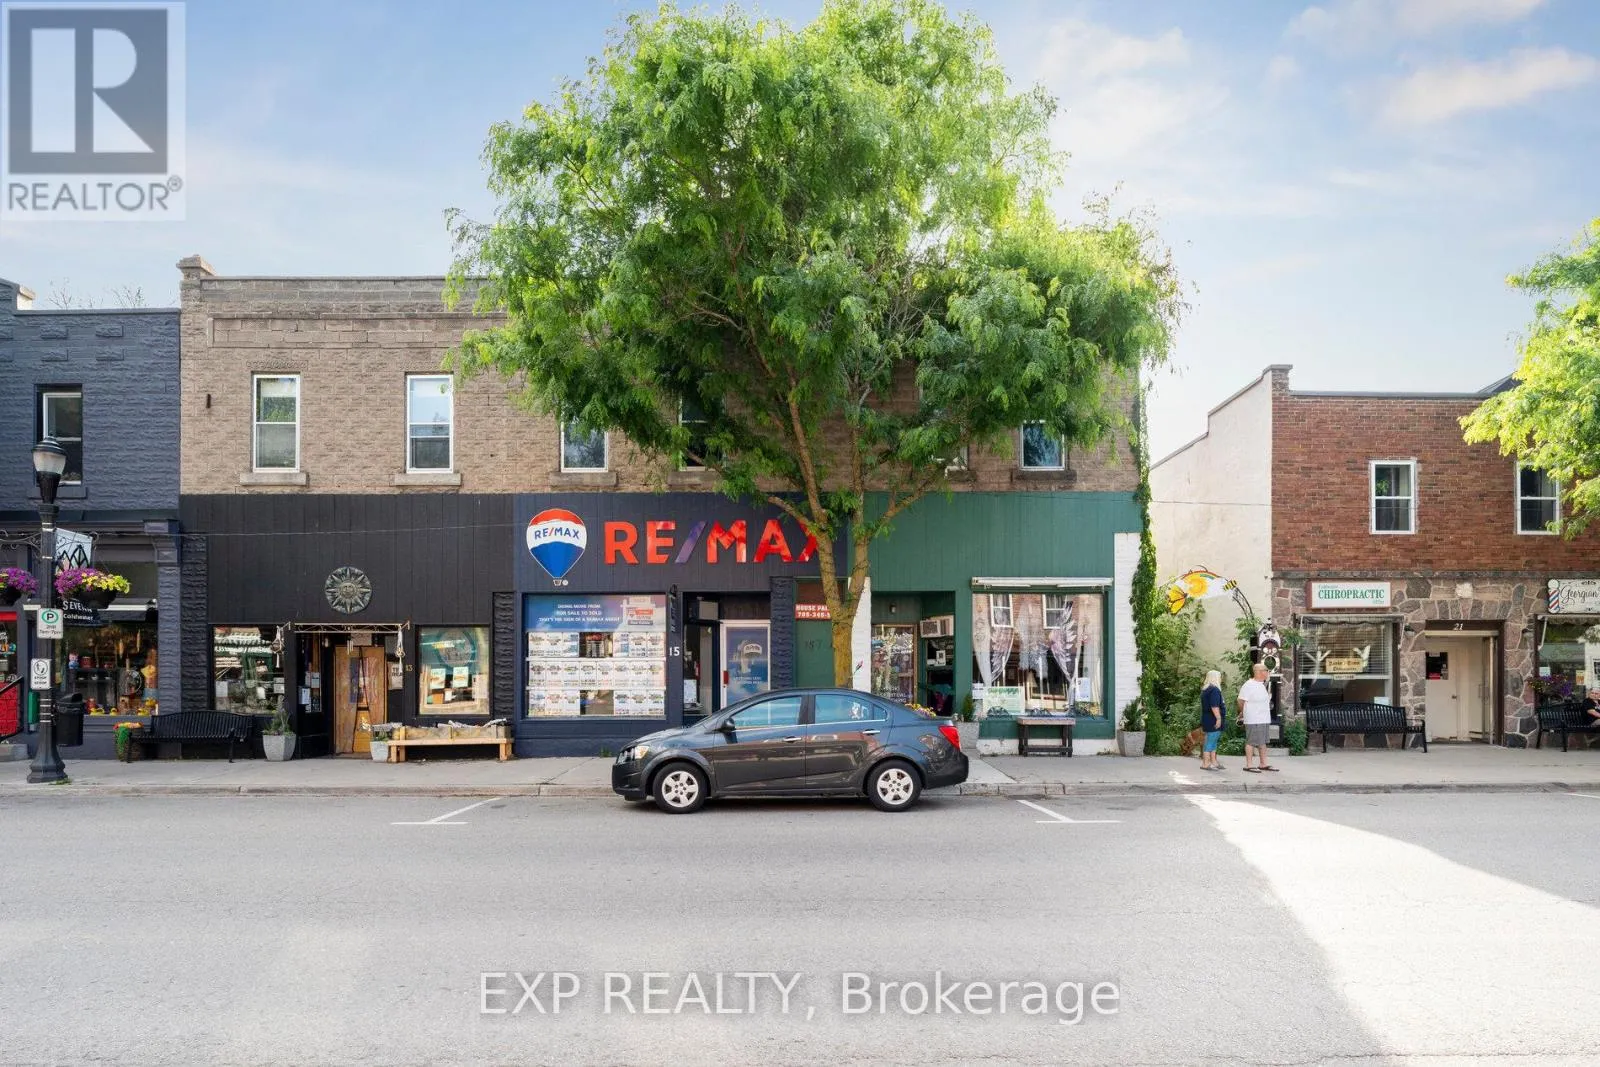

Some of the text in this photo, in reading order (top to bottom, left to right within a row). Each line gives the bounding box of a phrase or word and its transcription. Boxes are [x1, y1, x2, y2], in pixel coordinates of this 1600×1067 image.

[534, 526, 580, 540] RE/MAX
[1318, 589, 1385, 599] CHIROPRACTIC
[1453, 623, 1463, 631] 21
[669, 646, 680, 656] 15
